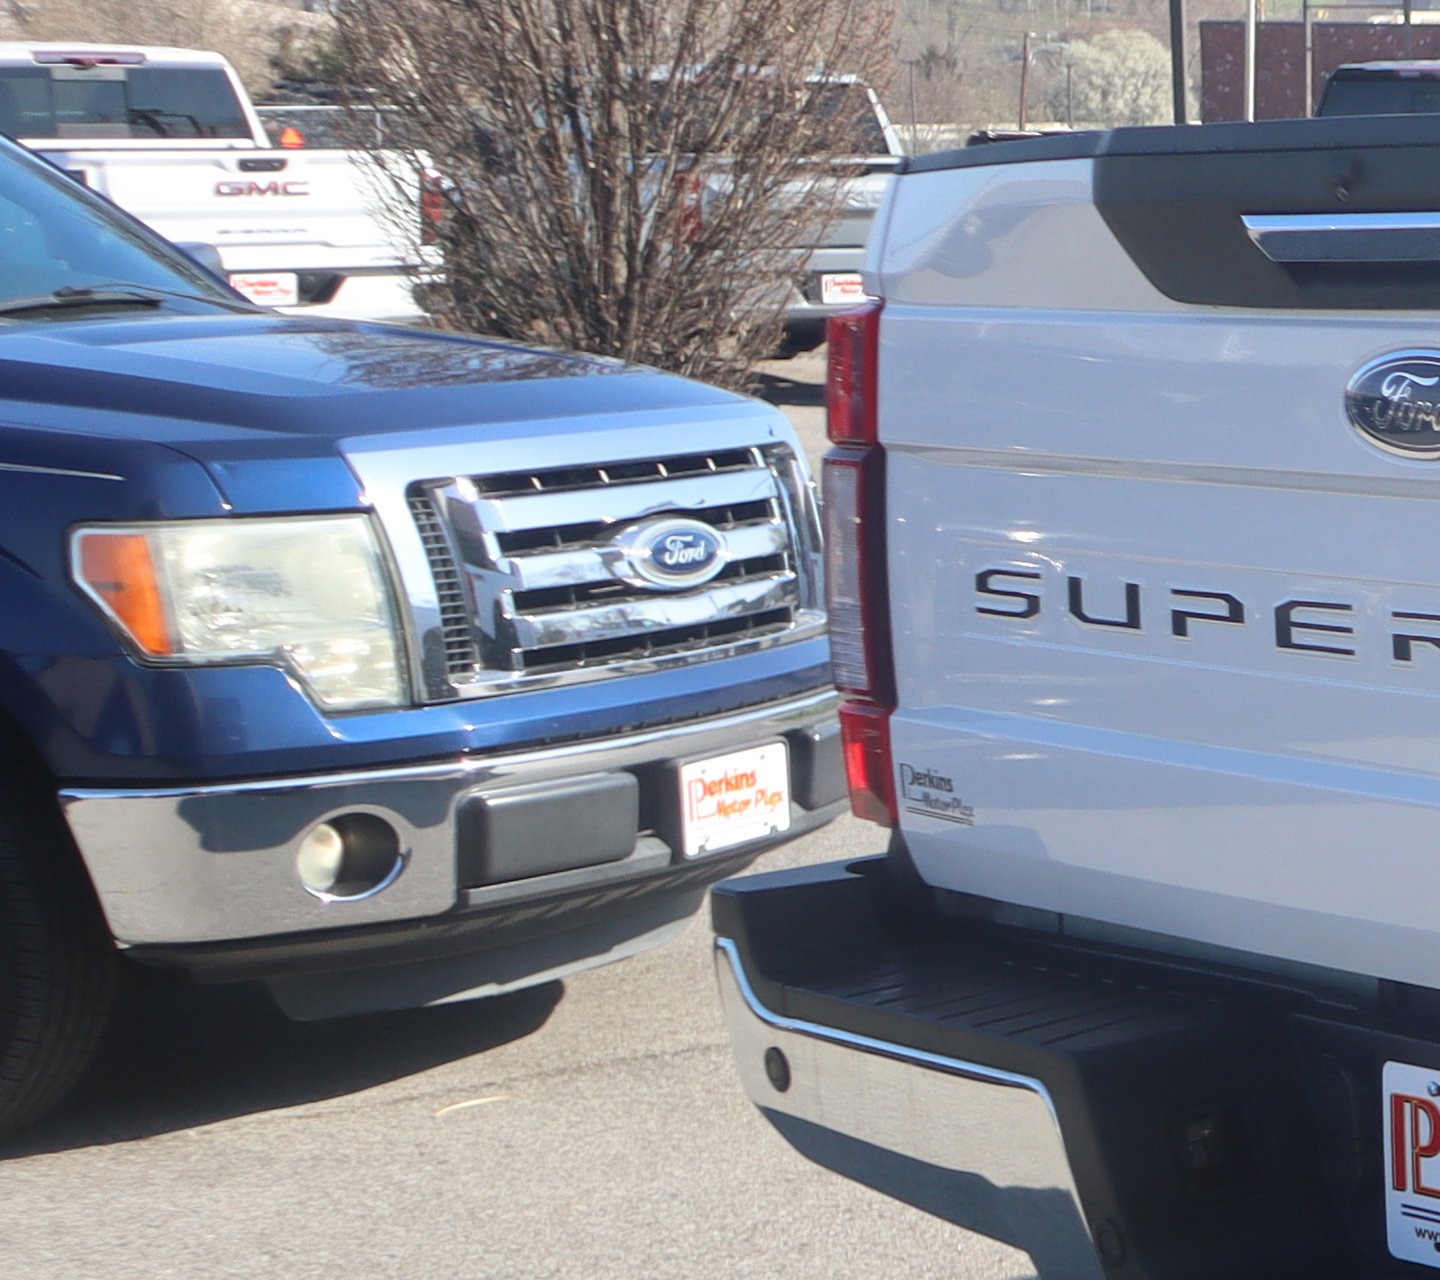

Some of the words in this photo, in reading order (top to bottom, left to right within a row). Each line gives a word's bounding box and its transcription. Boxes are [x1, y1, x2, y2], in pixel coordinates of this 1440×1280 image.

[214, 181, 310, 197] GMC
[664, 534, 707, 566] Ford
[688, 768, 758, 819] Perkins
